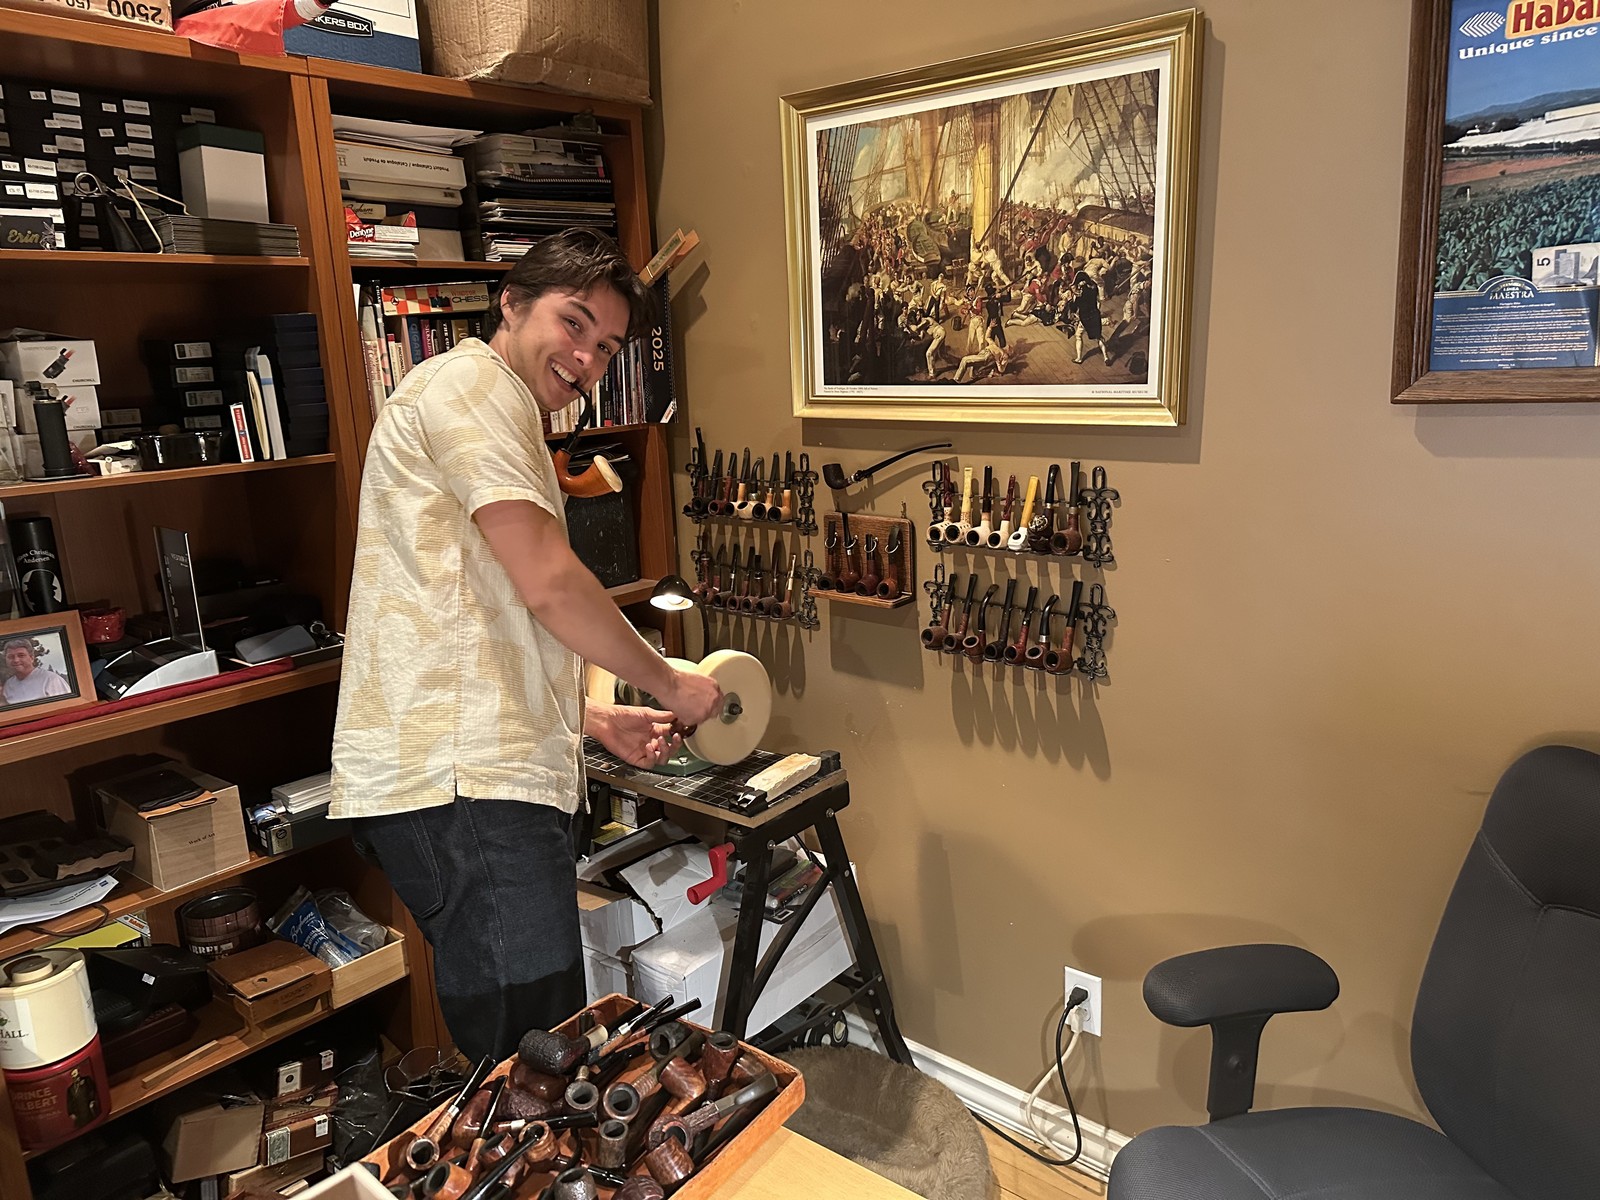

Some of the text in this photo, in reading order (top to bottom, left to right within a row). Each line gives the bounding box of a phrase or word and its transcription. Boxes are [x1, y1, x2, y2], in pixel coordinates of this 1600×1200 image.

[107, 0, 163, 25] 2500
[1512, 0, 1600, 34] Haba
[314, 15, 369, 33] KERS BOX
[1459, 26, 1598, 59] Unique since
[8, 229, 40, 244] Erin
[349, 226, 375, 239] Dentyne
[1537, 257, 1551, 267] 5
[451, 294, 489, 304] CHESS
[410, 323, 422, 362] CIGARS
[651, 326, 665, 372] 2025
